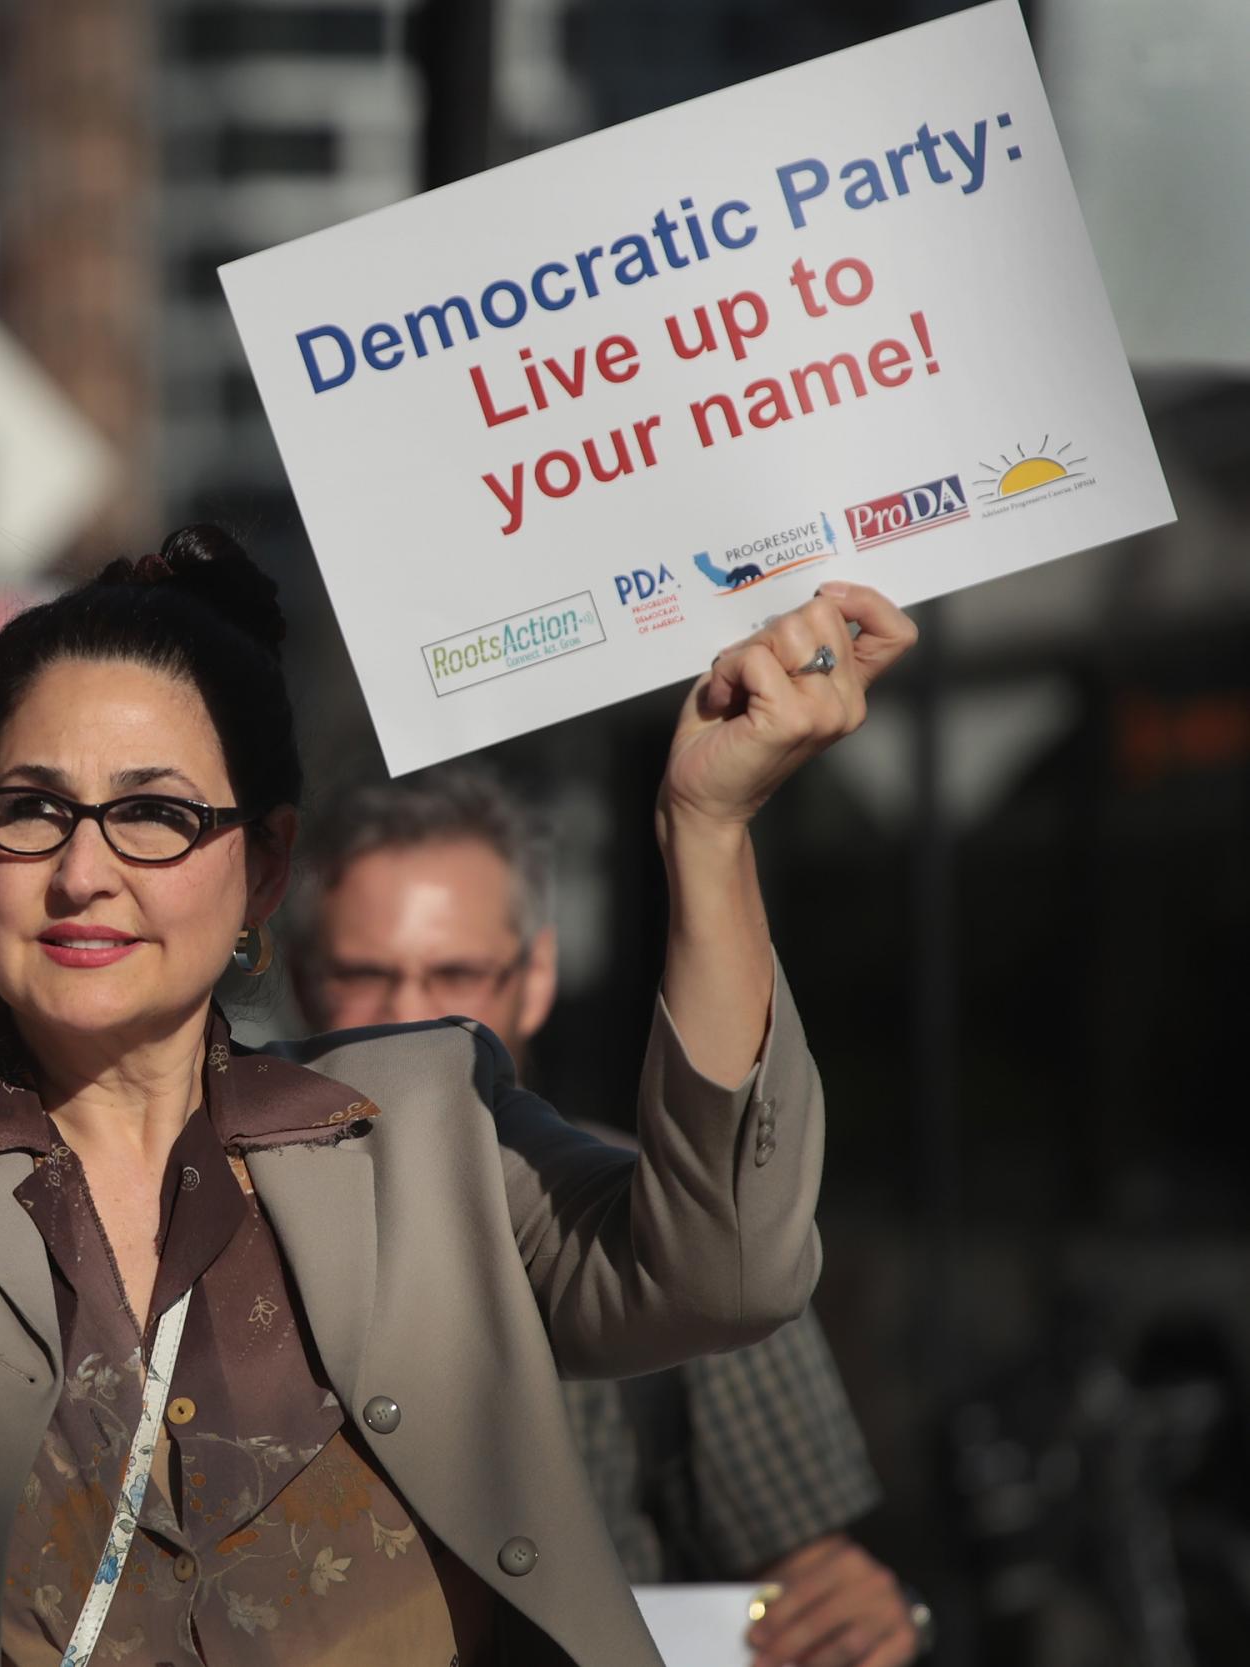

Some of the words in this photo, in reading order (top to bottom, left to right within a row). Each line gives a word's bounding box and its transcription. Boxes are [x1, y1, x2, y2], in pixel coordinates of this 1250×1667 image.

[296, 201, 757, 394] Democratic
[776, 114, 1021, 229] Party:
[469, 335, 640, 428] Live
[665, 291, 768, 361] up
[790, 259, 873, 317] to
[482, 416, 660, 535] your
[690, 312, 939, 448] name!
[725, 522, 818, 562] PROGRESSIVE
[850, 479, 967, 541] ProDA
[614, 561, 675, 606] PDA
[765, 538, 824, 567] CAUCUS
[432, 609, 579, 679] RootsAction
